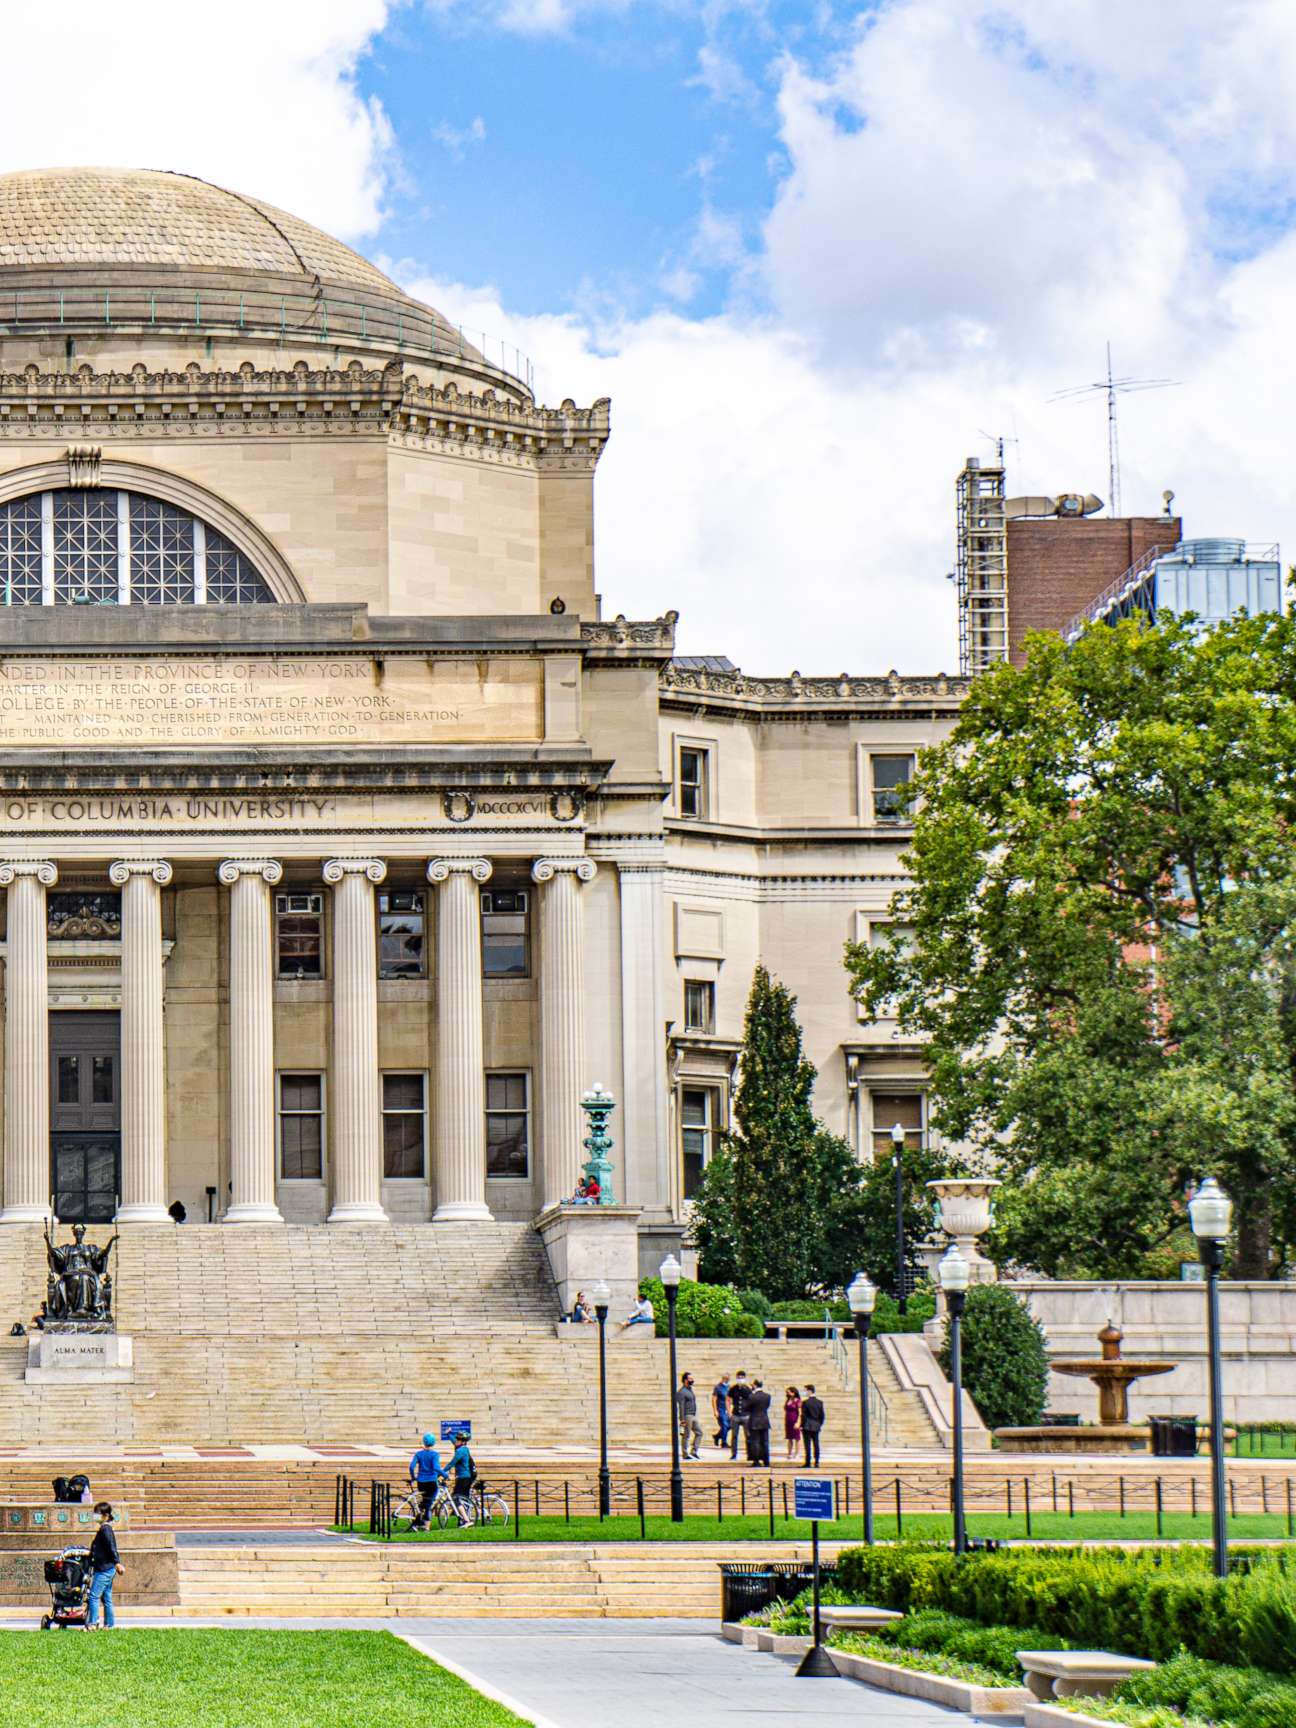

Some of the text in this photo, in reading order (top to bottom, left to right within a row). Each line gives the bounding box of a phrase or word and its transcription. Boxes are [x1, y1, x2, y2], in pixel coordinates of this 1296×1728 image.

[58, 666, 76, 680] IN
[86, 666, 122, 680] THE
[134, 665, 223, 680] PROVINCE
[233, 664, 258, 678] OF
[267, 664, 307, 678] NEW
[317, 664, 368, 678] YORK
[55, 684, 68, 694] IN
[77, 684, 103, 694] THE
[112, 684, 151, 694] REIGN
[159, 684, 177, 694] OF
[184, 684, 237, 694] GEORGE
[73, 699, 87, 710] BY
[96, 698, 122, 710] THE
[130, 698, 178, 710] PEOPLE
[184, 698, 203, 709] OF
[211, 698, 237, 708] THE
[244, 697, 282, 708] STATE
[290, 697, 307, 708] OF
[314, 697, 344, 708] NEW
[352, 696, 389, 707] YORK
[34, 714, 112, 724] MAINTAINED
[120, 714, 144, 724] AND
[152, 714, 220, 723] CHERISHED
[228, 712, 263, 722] FROM
[270, 712, 349, 722] GENERATION
[356, 712, 372, 721] TO
[380, 711, 460, 721] GENERATION
[23, 728, 64, 738] PUBLIC
[74, 728, 110, 738] GOOD
[117, 728, 143, 737] AND
[150, 727, 174, 736] THE
[182, 726, 222, 736] GLORY
[230, 726, 246, 736] OF
[254, 726, 320, 736] ALMIGHTY
[328, 725, 358, 735] GOD
[6, 802, 38, 820] OF
[50, 801, 174, 820] COLUMBIA
[186, 800, 327, 820] UNIVERSITY
